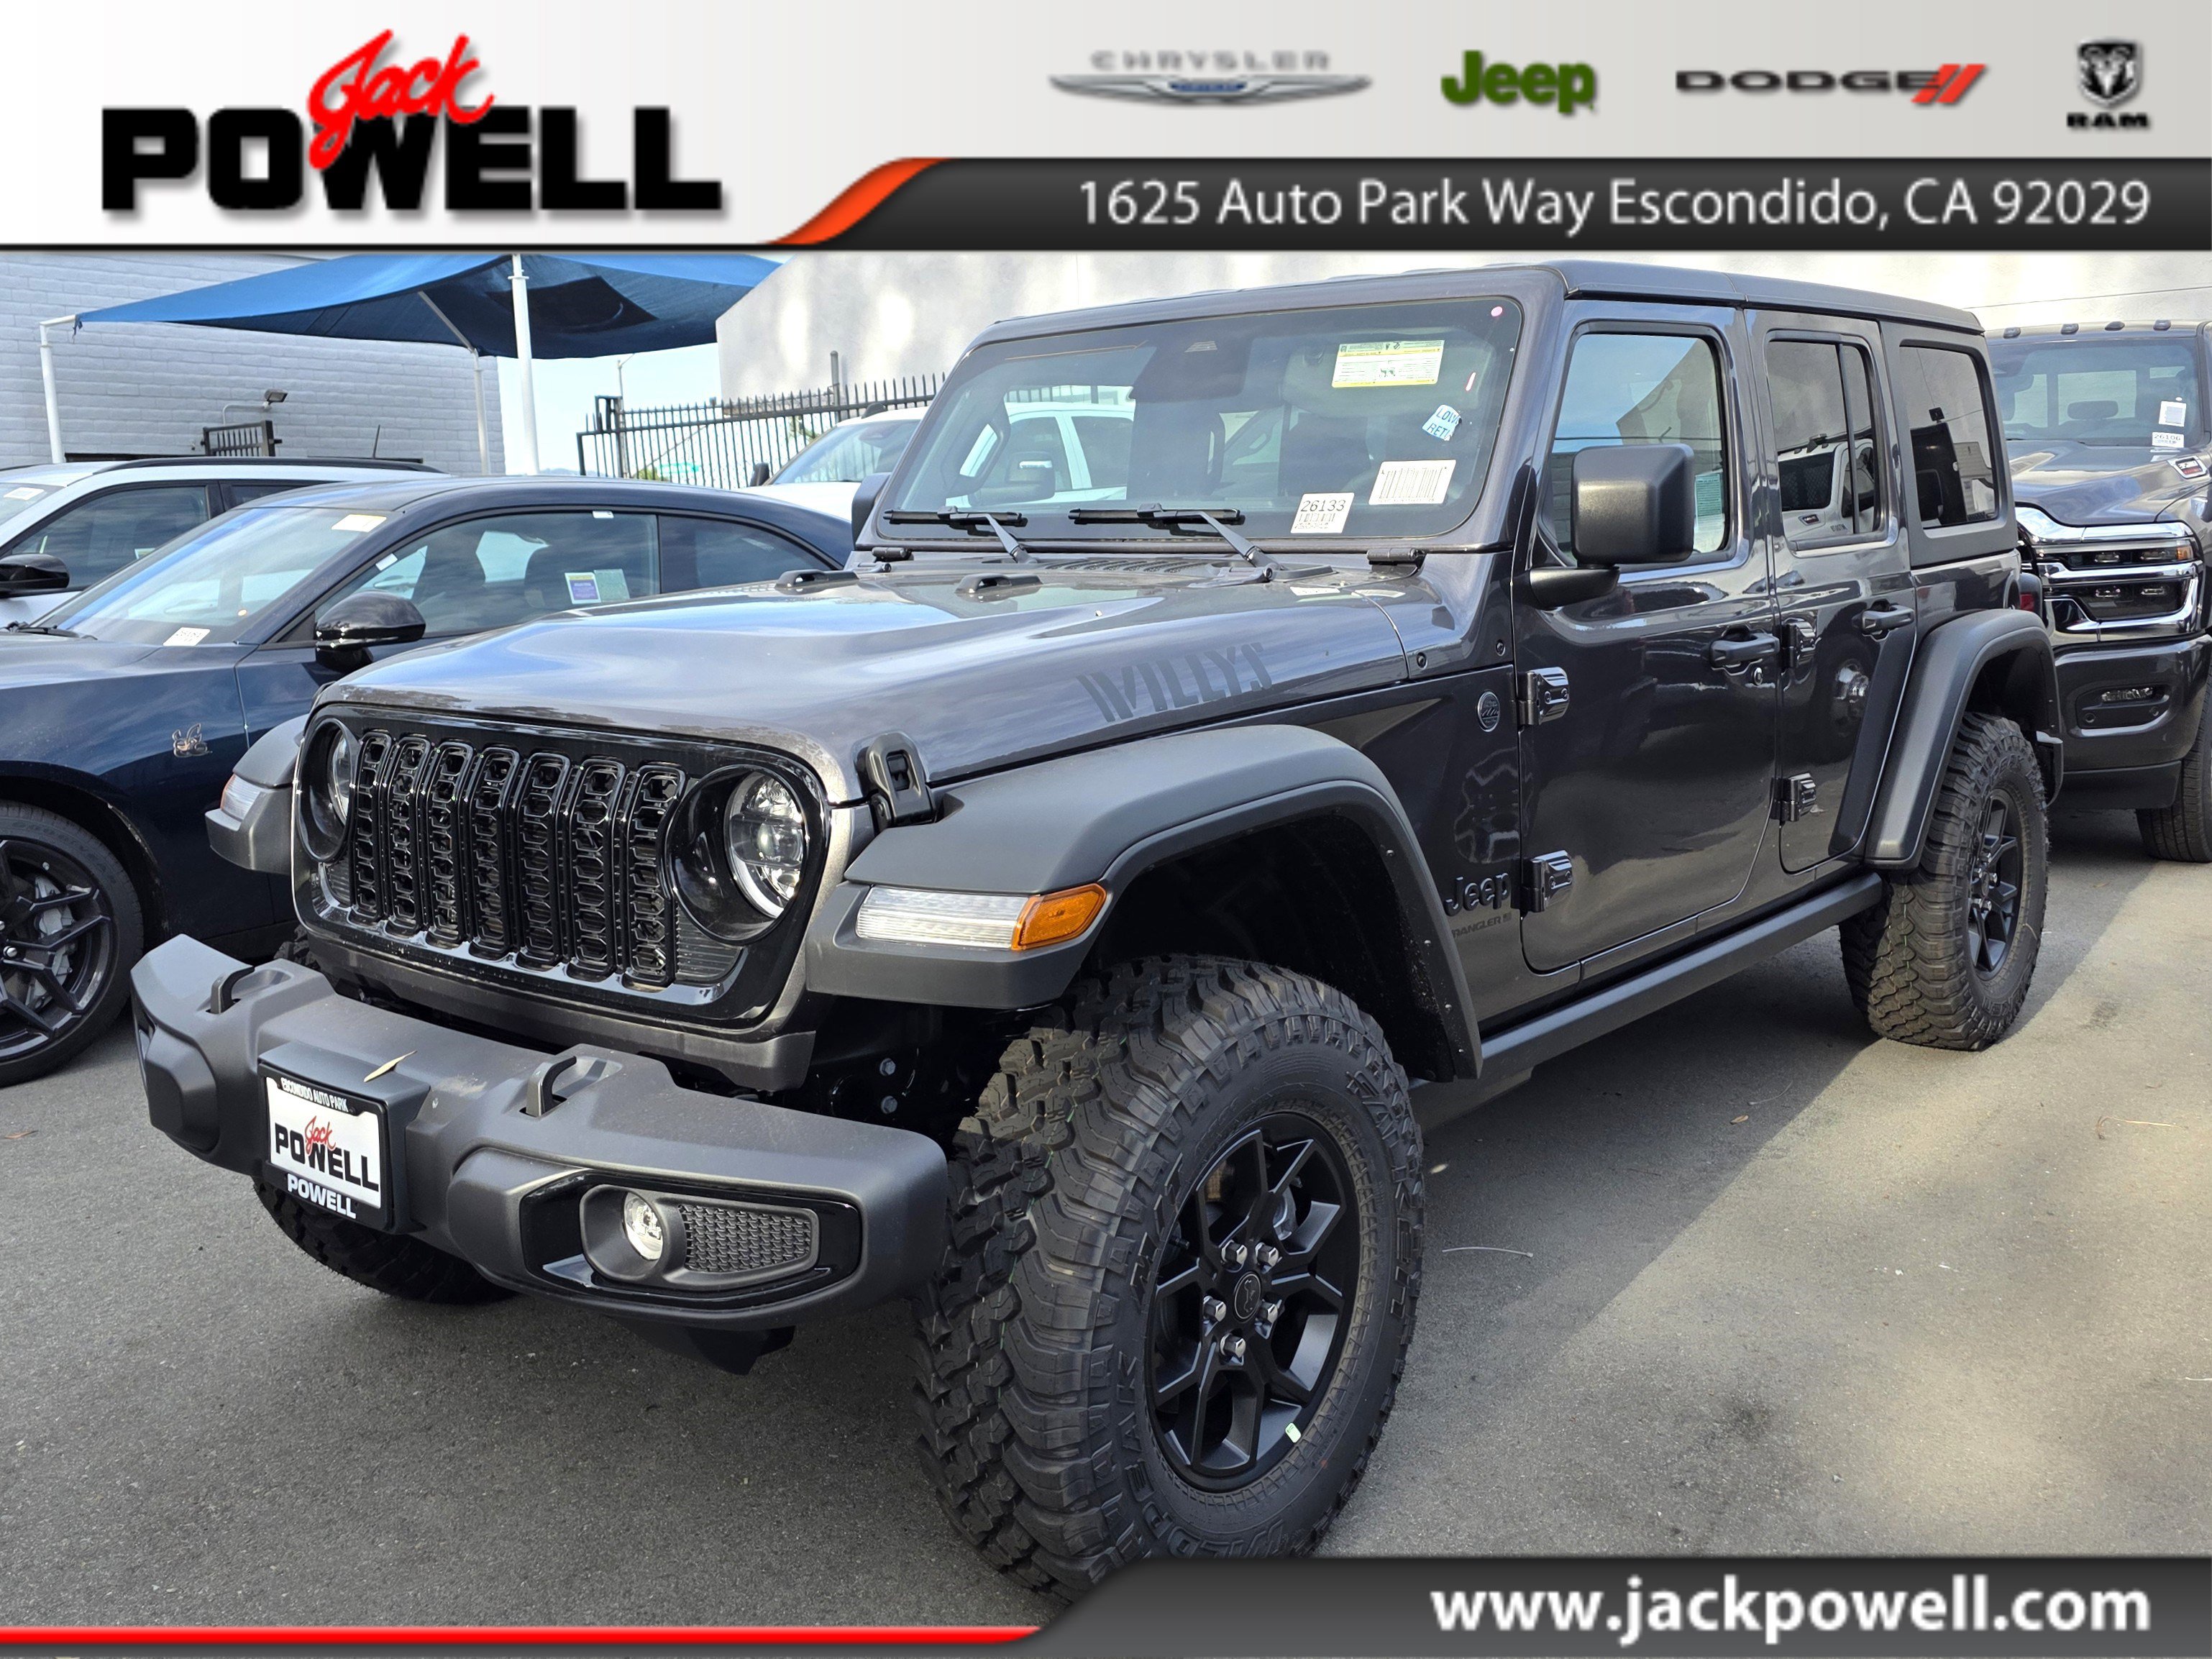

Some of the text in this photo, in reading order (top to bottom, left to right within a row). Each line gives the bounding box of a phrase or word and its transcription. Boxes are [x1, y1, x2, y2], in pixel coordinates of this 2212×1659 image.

[1300, 499, 1346, 512] 26133
[1076, 641, 1273, 723] WILLYS
[1445, 872, 1510, 917] Jeep
[313, 1089, 330, 1107] AUTO
[329, 1094, 349, 1112] PARK
[275, 1123, 380, 1192] POWELL
[304, 1115, 336, 1156] Jack
[288, 1173, 357, 1220] POWELL
